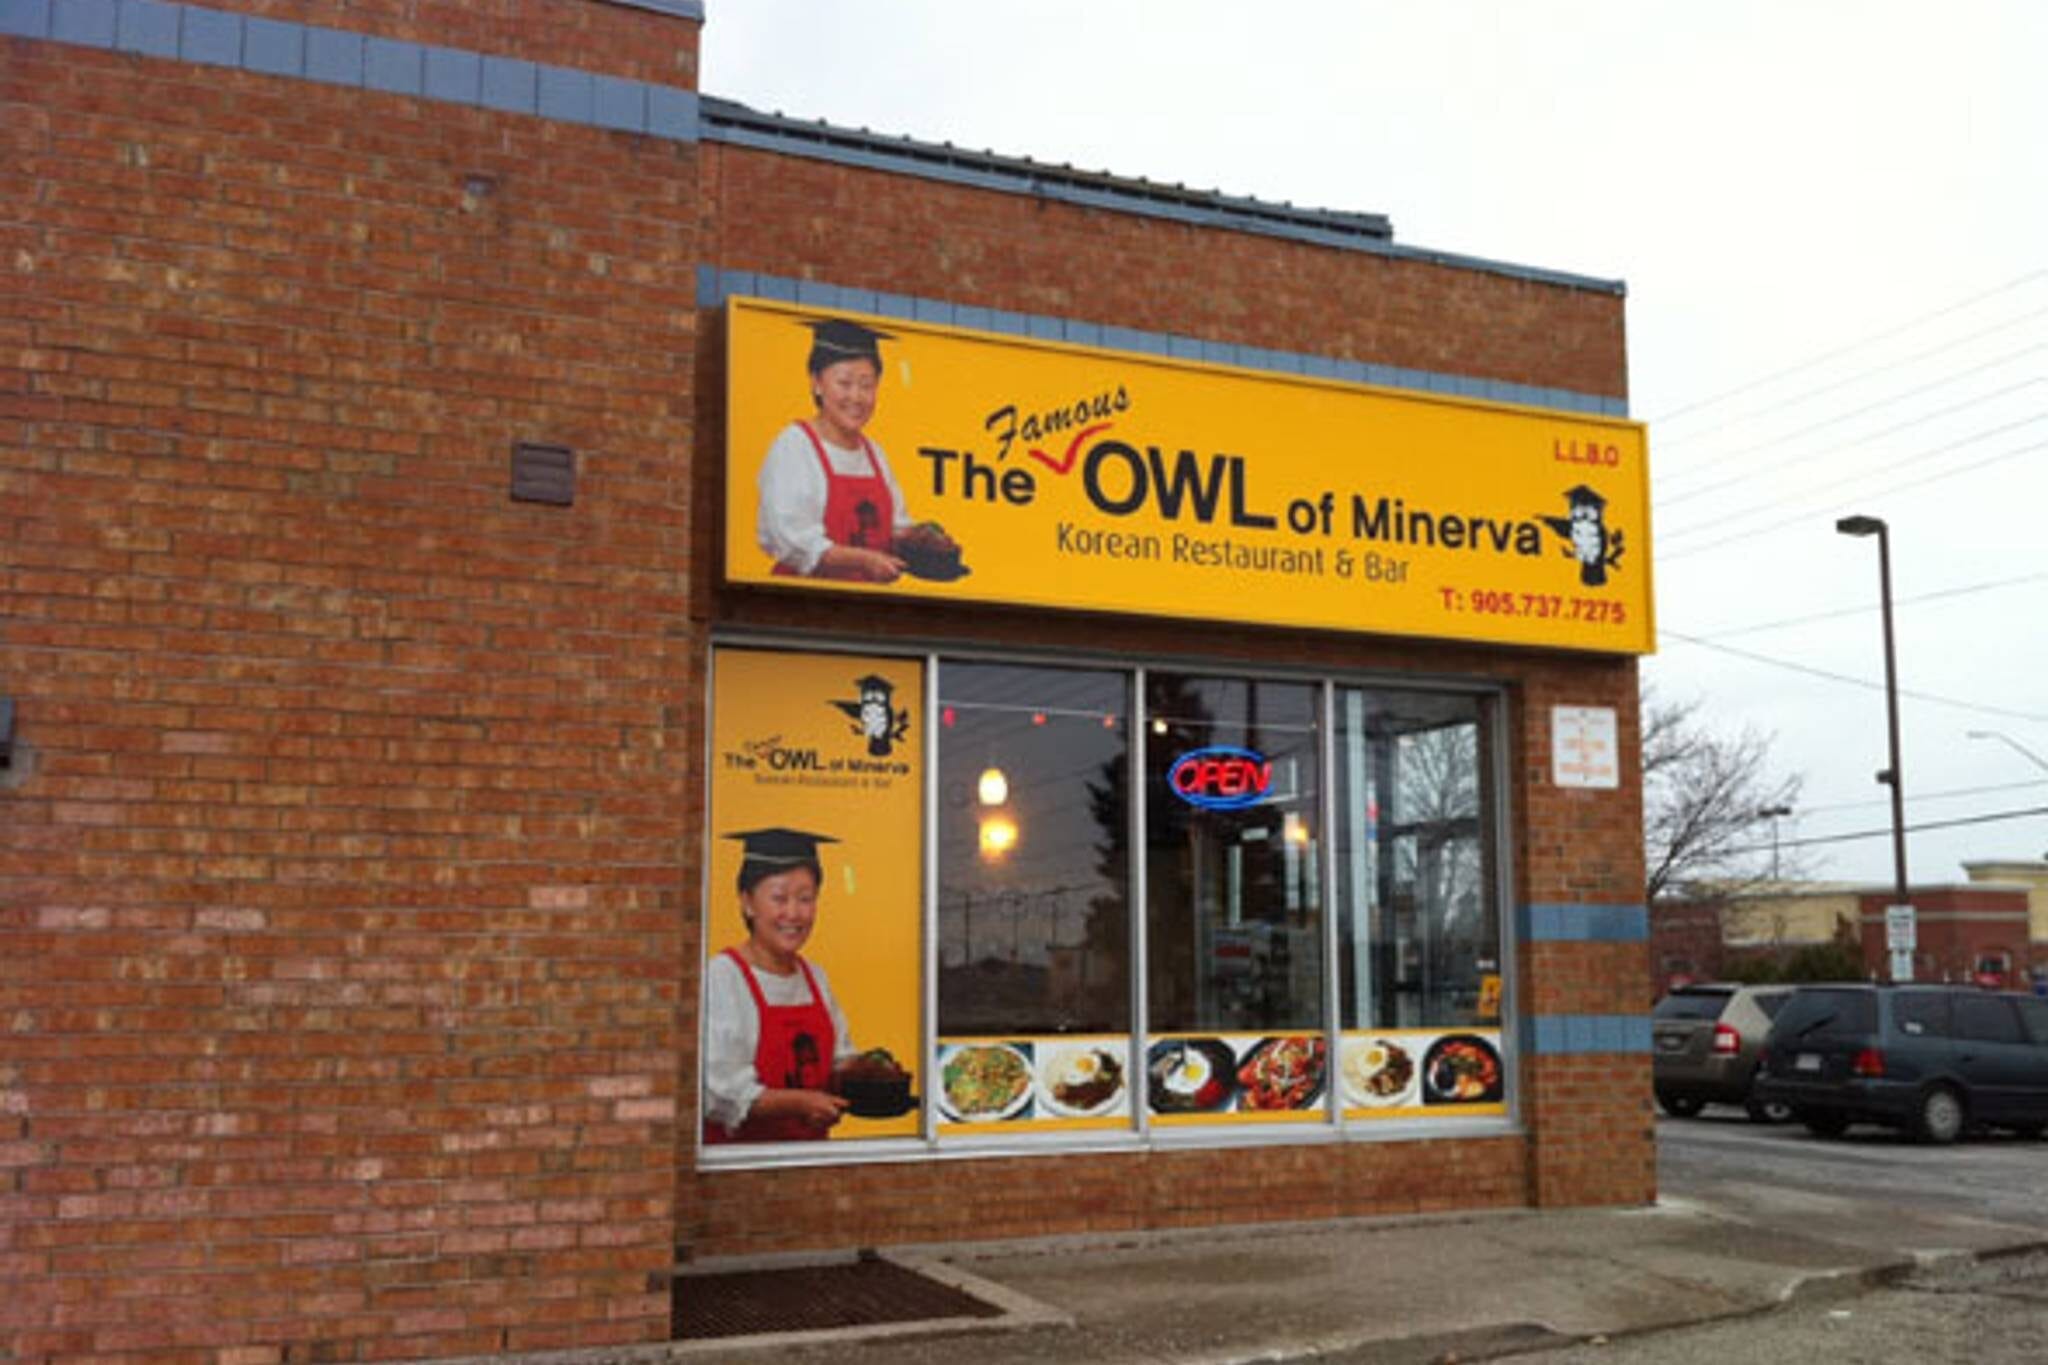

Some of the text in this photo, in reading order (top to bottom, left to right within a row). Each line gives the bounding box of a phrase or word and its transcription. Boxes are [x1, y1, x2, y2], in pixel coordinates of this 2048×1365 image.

[985, 384, 1131, 461] Famous
[918, 440, 1543, 556] The OWL of Minerva
[1057, 522, 1410, 584] Korean Restaurant & Bar
[1438, 586, 1626, 625] T: 905.737.7275
[768, 748, 828, 771] OWL
[1173, 758, 1273, 796] OPEN
